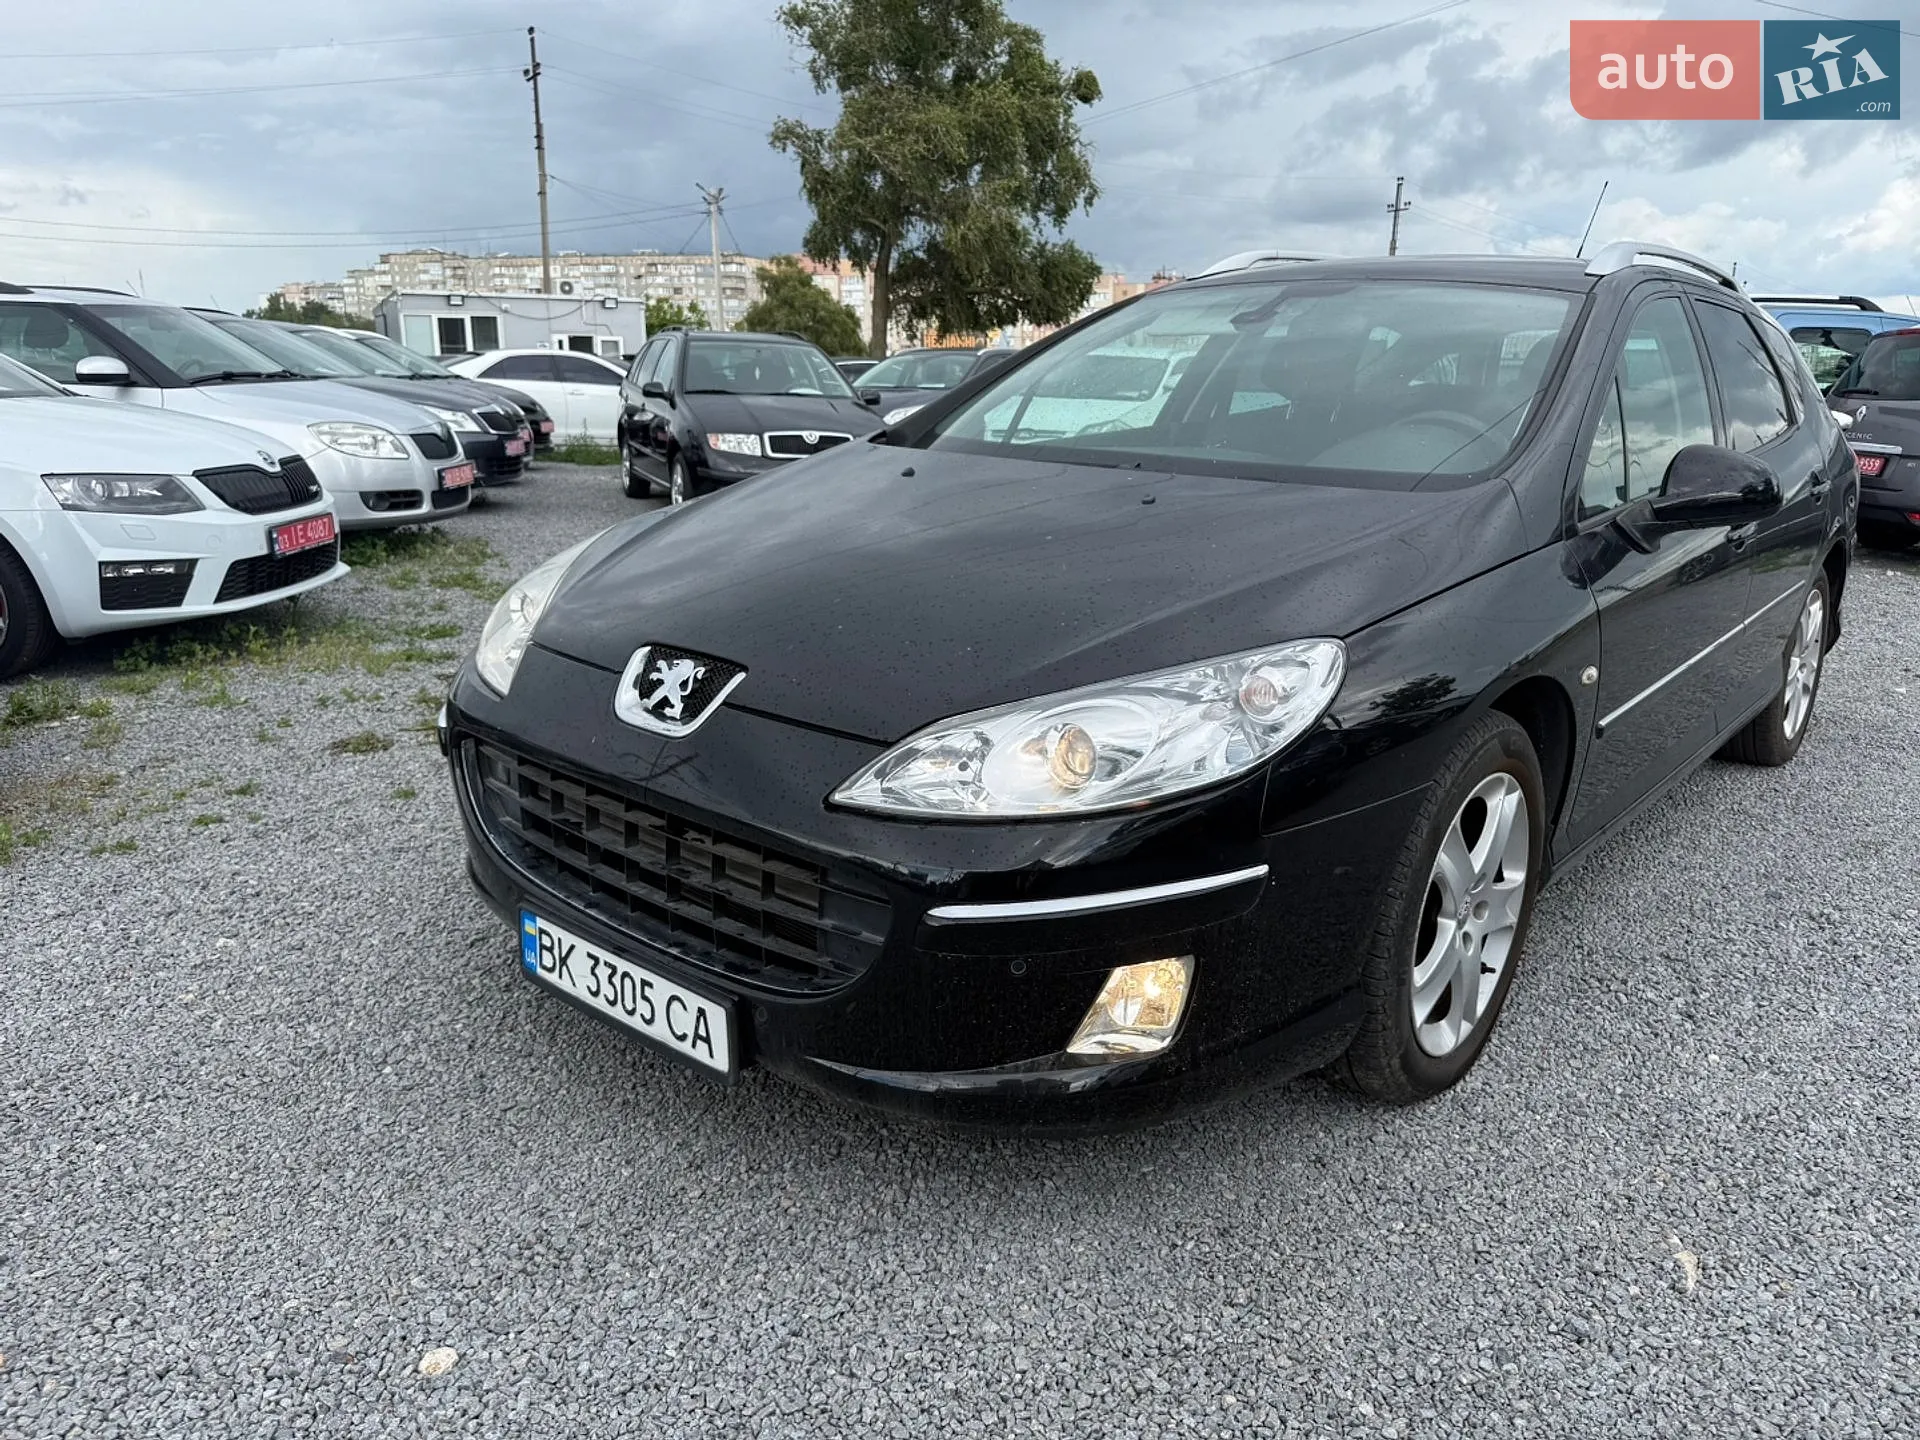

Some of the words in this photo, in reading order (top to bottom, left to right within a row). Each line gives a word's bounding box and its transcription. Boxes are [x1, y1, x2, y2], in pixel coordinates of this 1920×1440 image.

[1845, 432, 1873, 440] CENIC
[525, 947, 536, 969] UA
[538, 926, 577, 988] BK
[586, 951, 656, 1026] 3305
[665, 994, 715, 1060] CA
